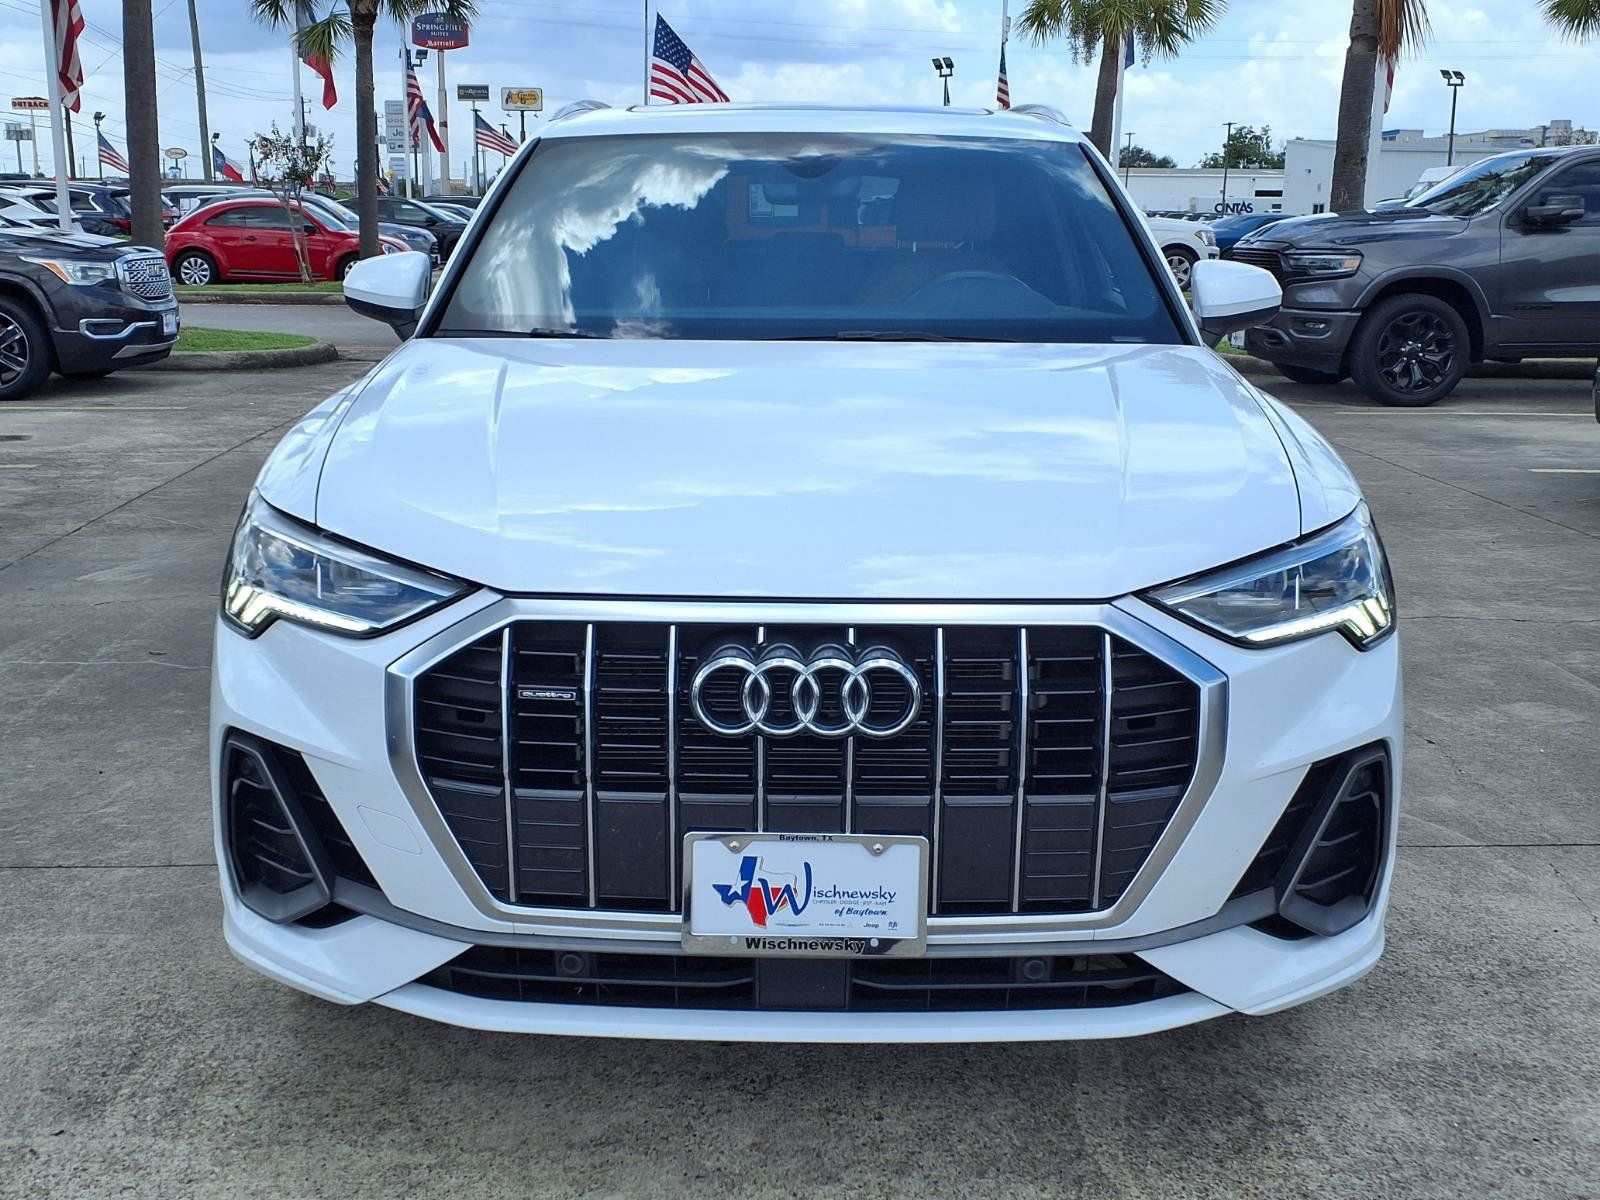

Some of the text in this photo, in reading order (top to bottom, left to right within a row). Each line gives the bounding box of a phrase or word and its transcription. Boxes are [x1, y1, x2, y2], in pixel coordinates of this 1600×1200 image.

[1215, 201, 1253, 213] CNTAS
[521, 691, 572, 699] quattro
[779, 834, 819, 842] Baytown,
[757, 861, 897, 916] Wischnewsky
[834, 906, 888, 917] of Baytown
[745, 937, 865, 954] Wischnewsky
